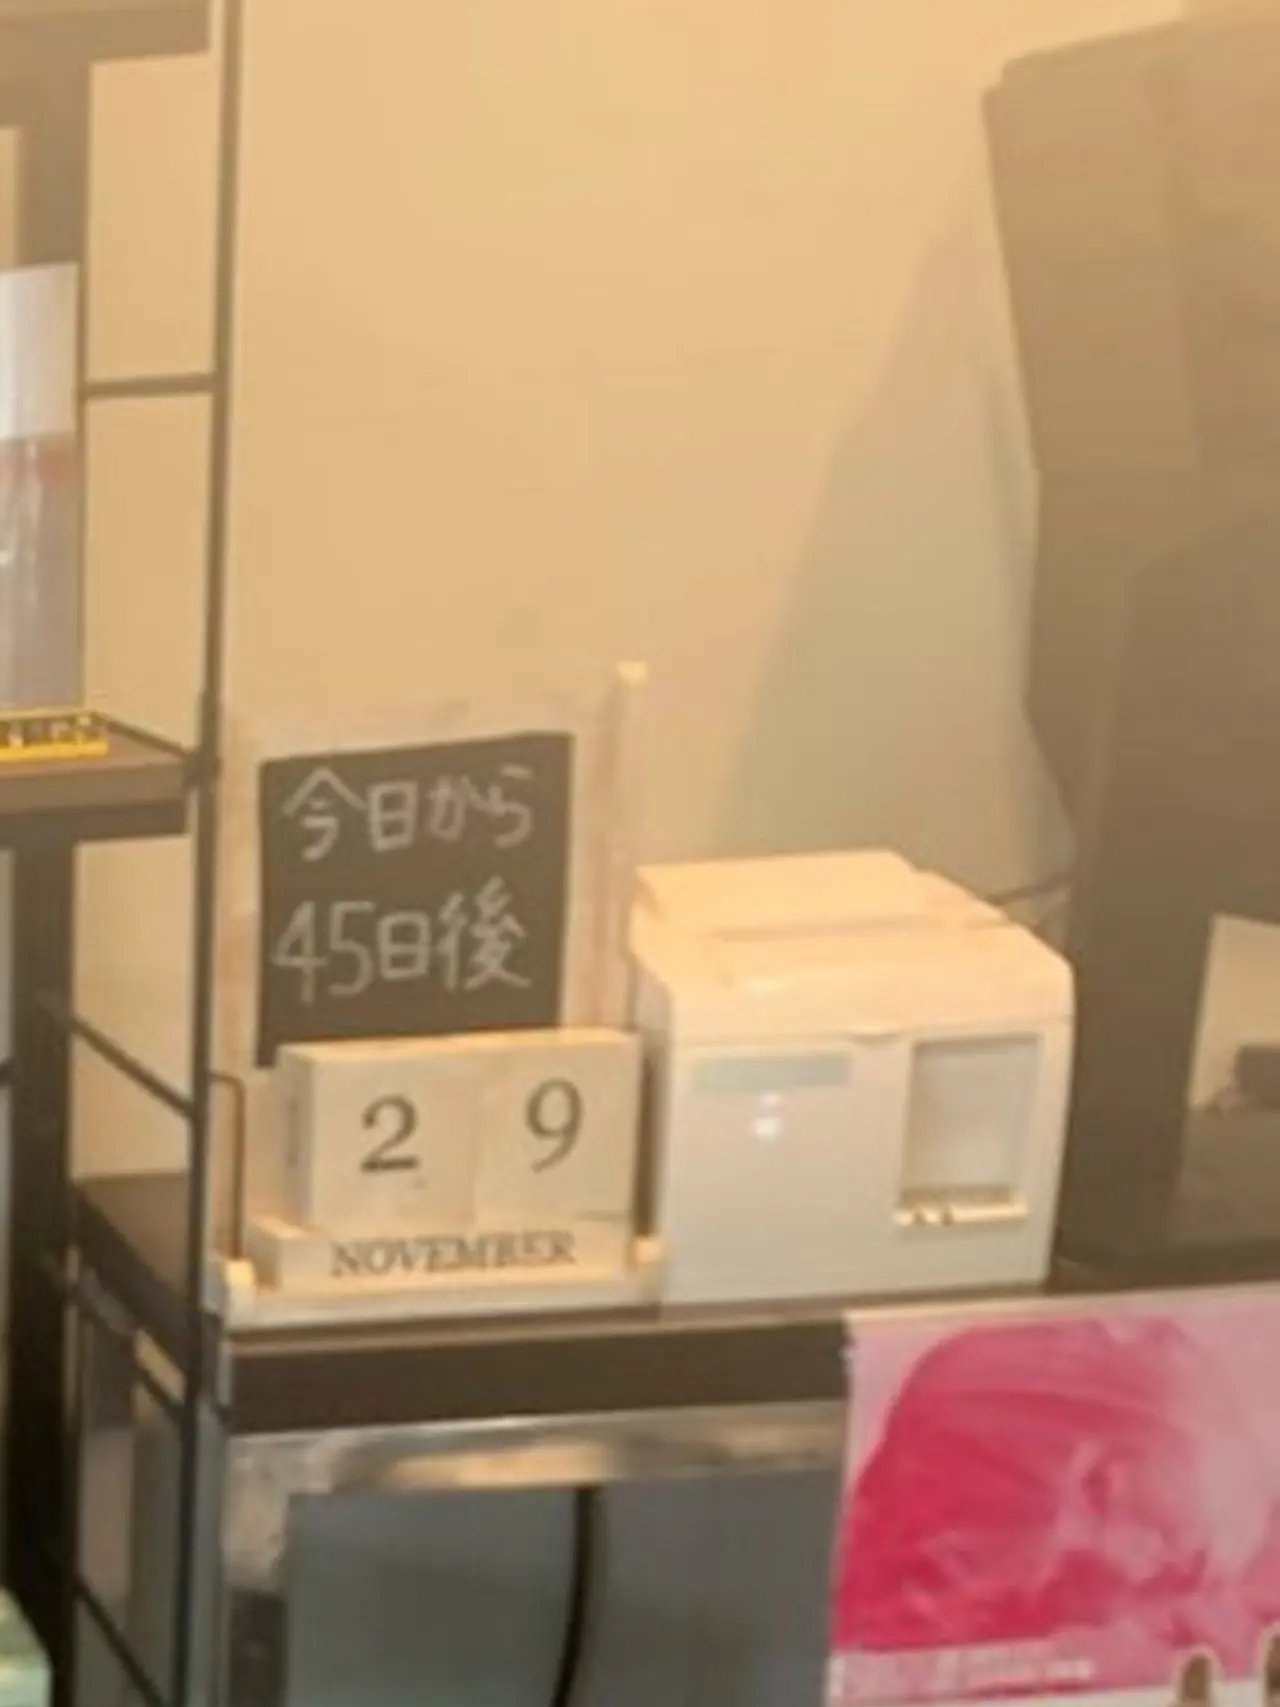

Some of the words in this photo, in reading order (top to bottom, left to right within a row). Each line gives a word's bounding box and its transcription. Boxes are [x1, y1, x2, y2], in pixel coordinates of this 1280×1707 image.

[281, 765, 536, 861] 今日から
[271, 873, 534, 1004] 45日後
[359, 1093, 419, 1173] 2
[524, 1076, 584, 1174] 9
[329, 1230, 577, 1278] NOVEMBER
